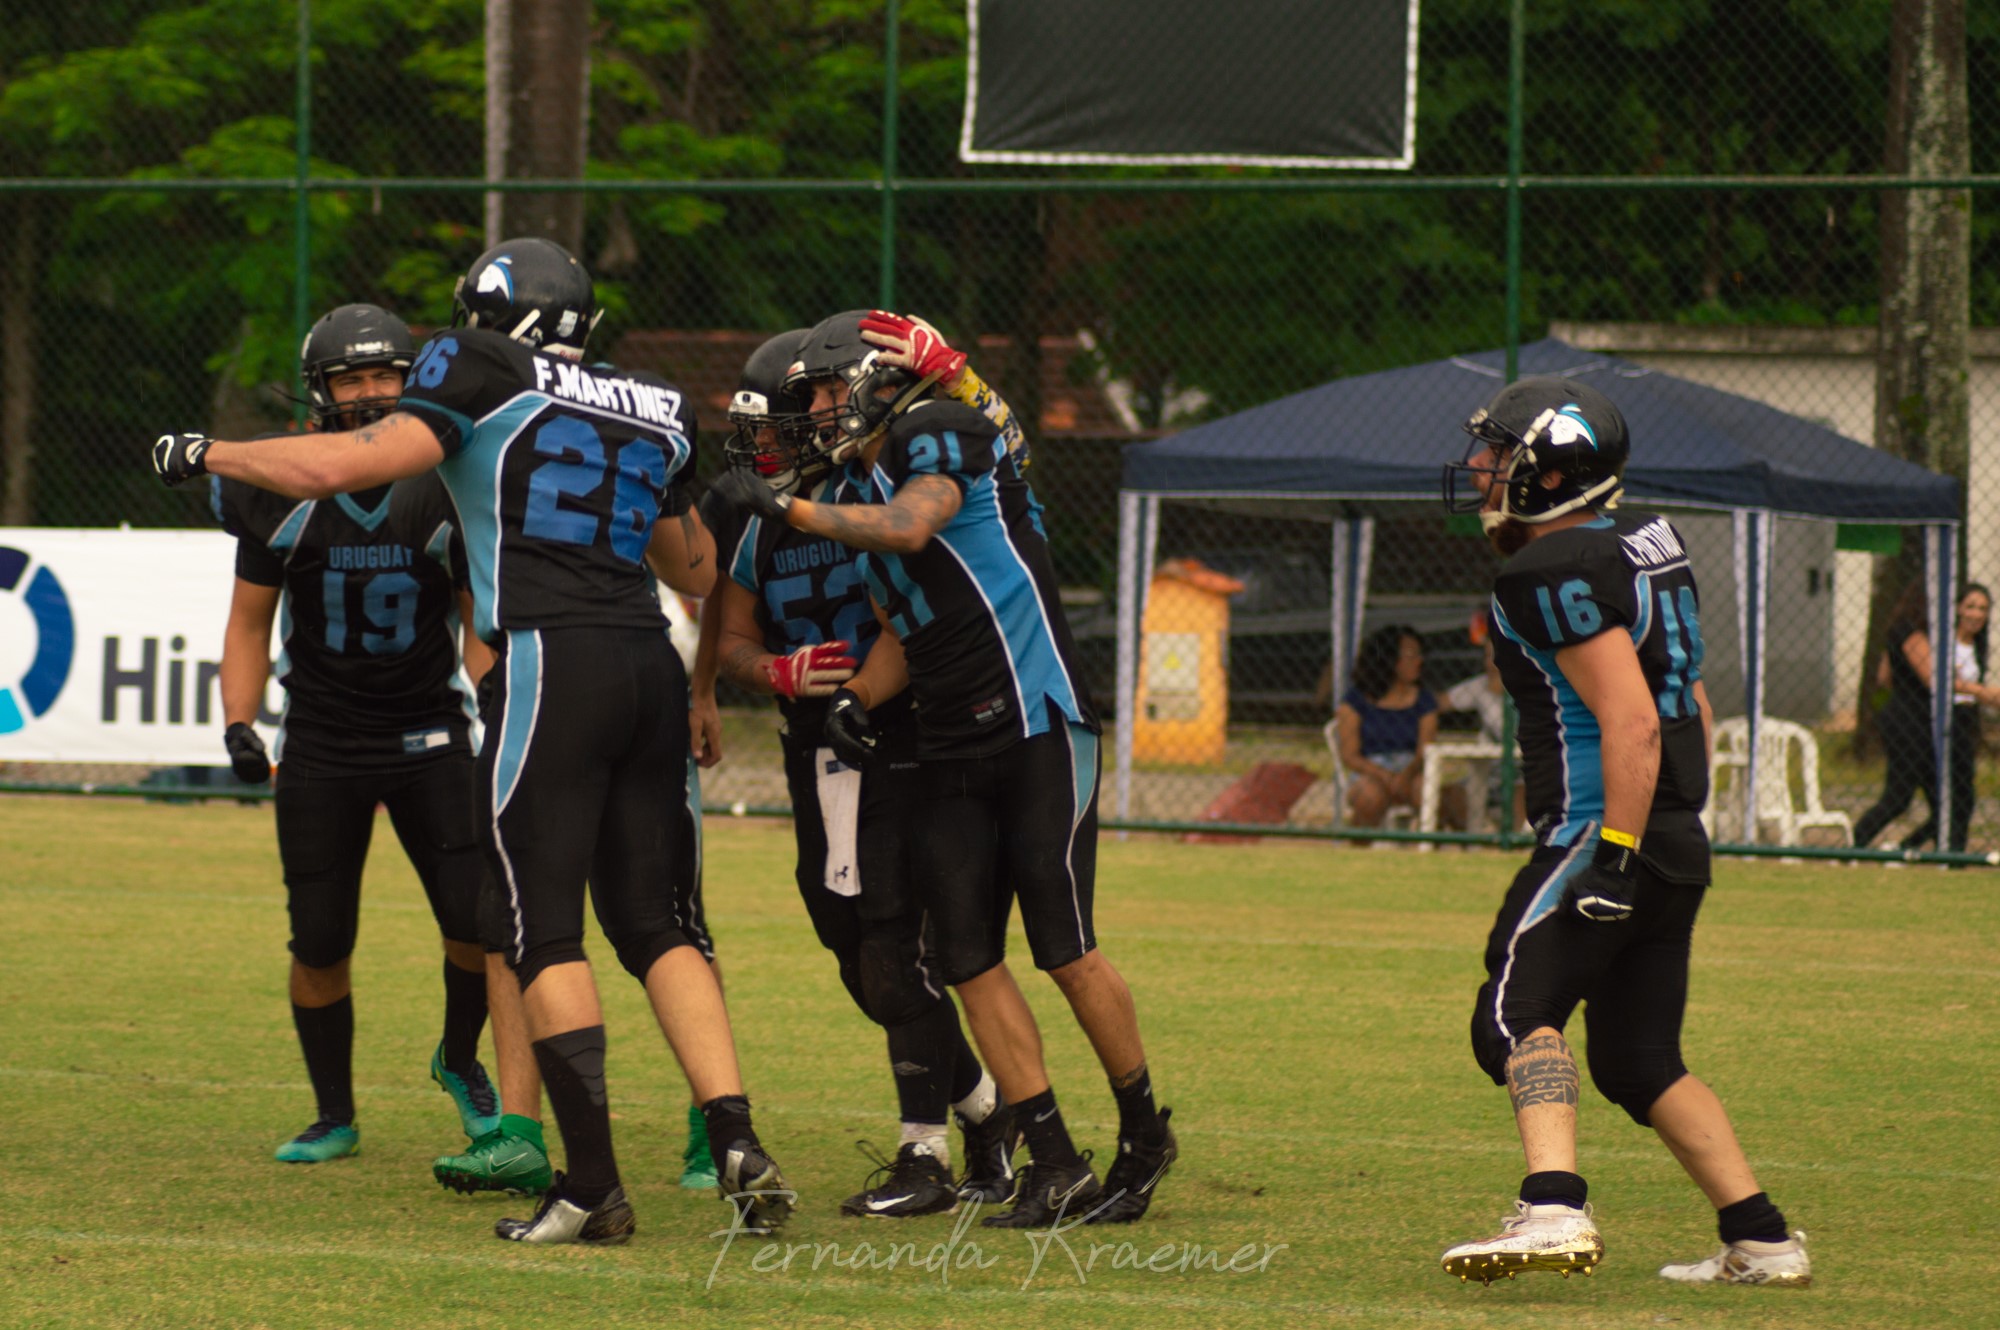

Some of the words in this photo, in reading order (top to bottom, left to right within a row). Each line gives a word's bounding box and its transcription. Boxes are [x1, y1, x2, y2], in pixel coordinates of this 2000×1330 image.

[908, 431, 963, 474] 21
[522, 414, 667, 566] 26
[329, 544, 413, 569] URUGUAY
[773, 540, 848, 574] URUGUA
[322, 570, 421, 655] 19
[1536, 578, 1603, 644] 16
